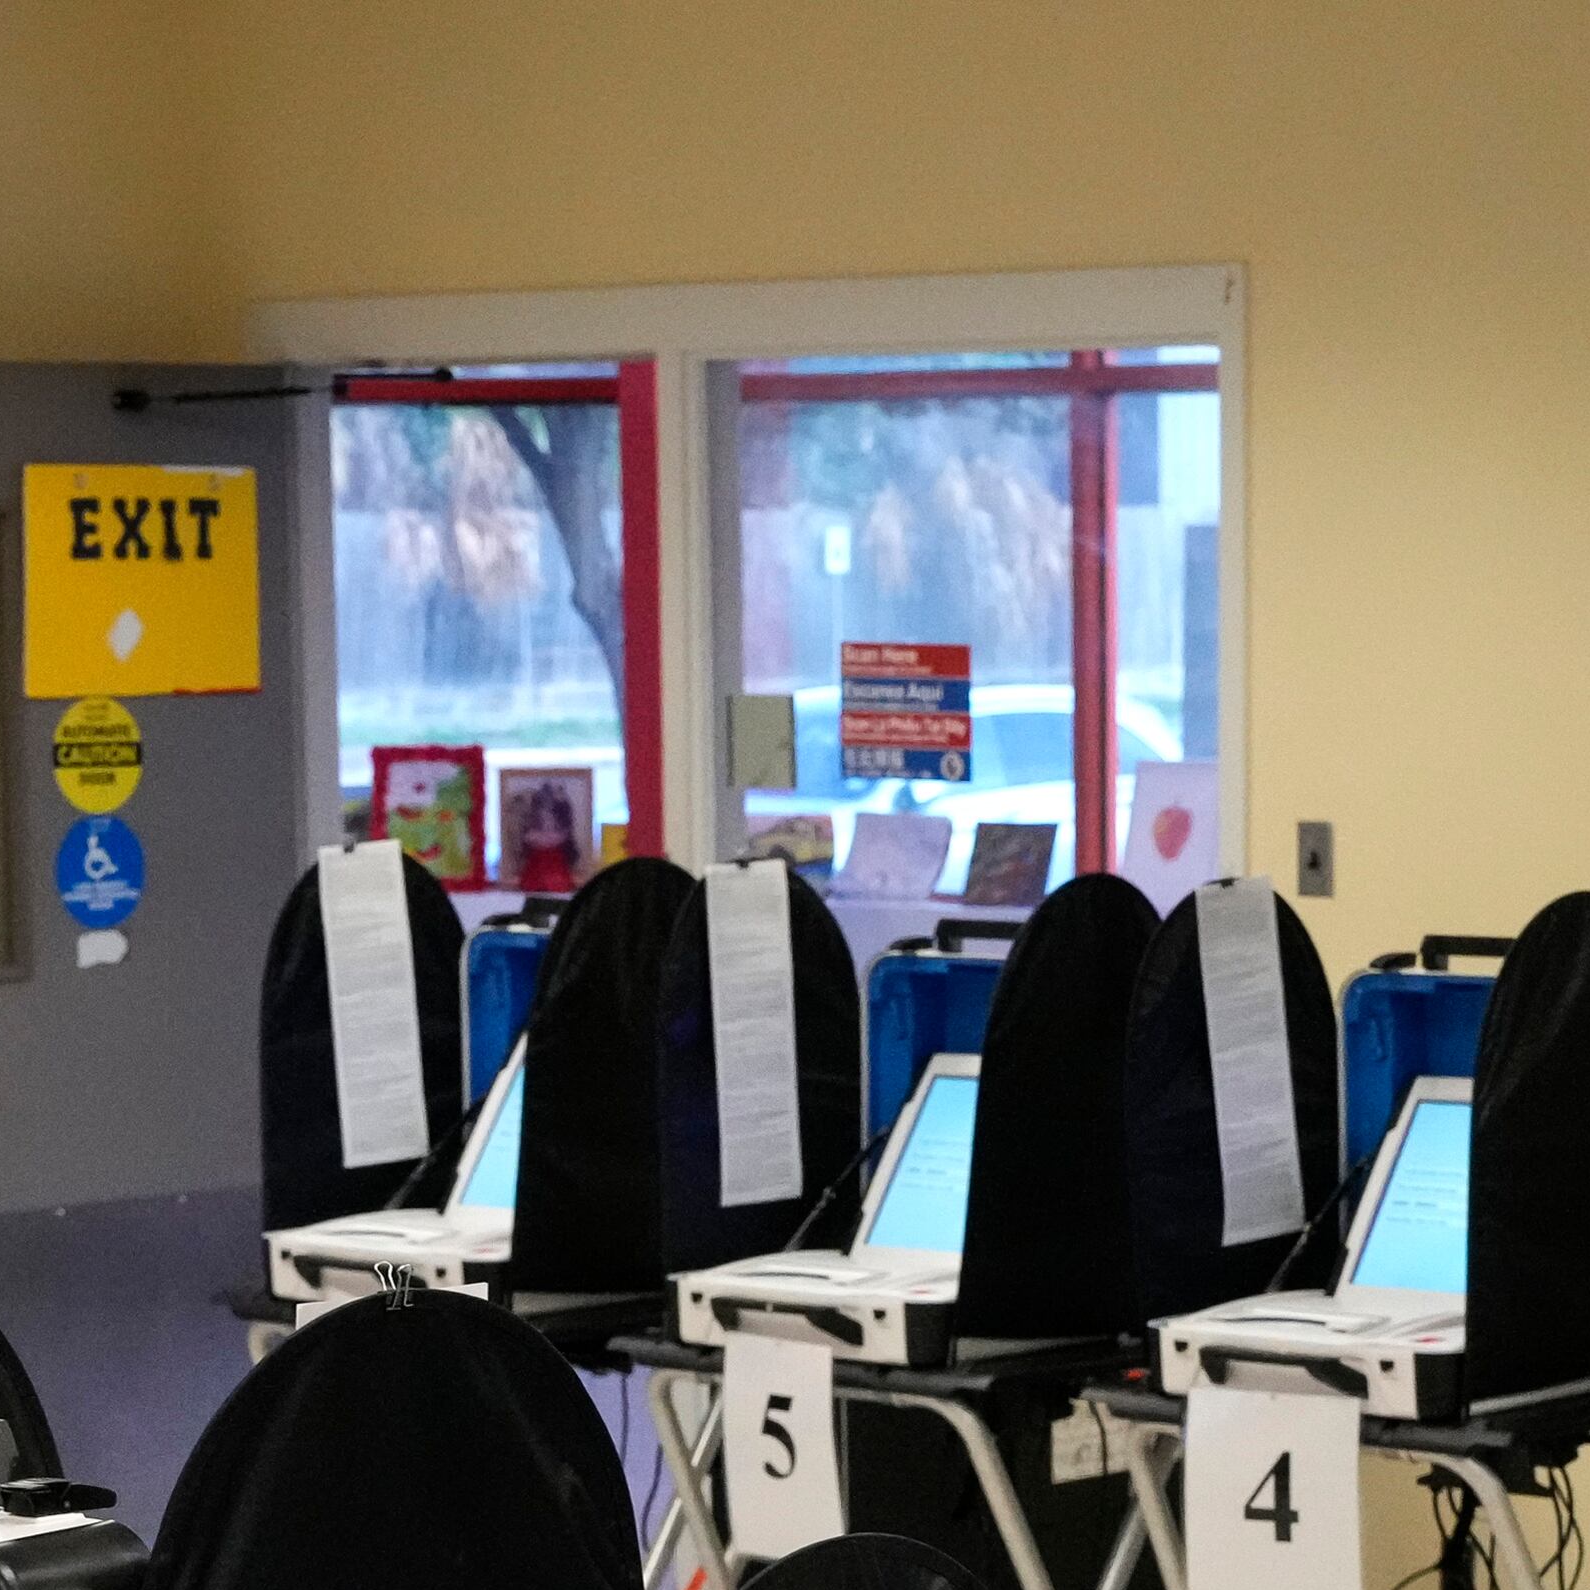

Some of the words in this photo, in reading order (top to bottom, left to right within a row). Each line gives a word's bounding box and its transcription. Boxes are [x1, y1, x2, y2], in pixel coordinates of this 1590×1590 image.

[69, 497, 220, 561] EXIT
[761, 1394, 797, 1479] 5
[1244, 1451, 1299, 1543] 4
